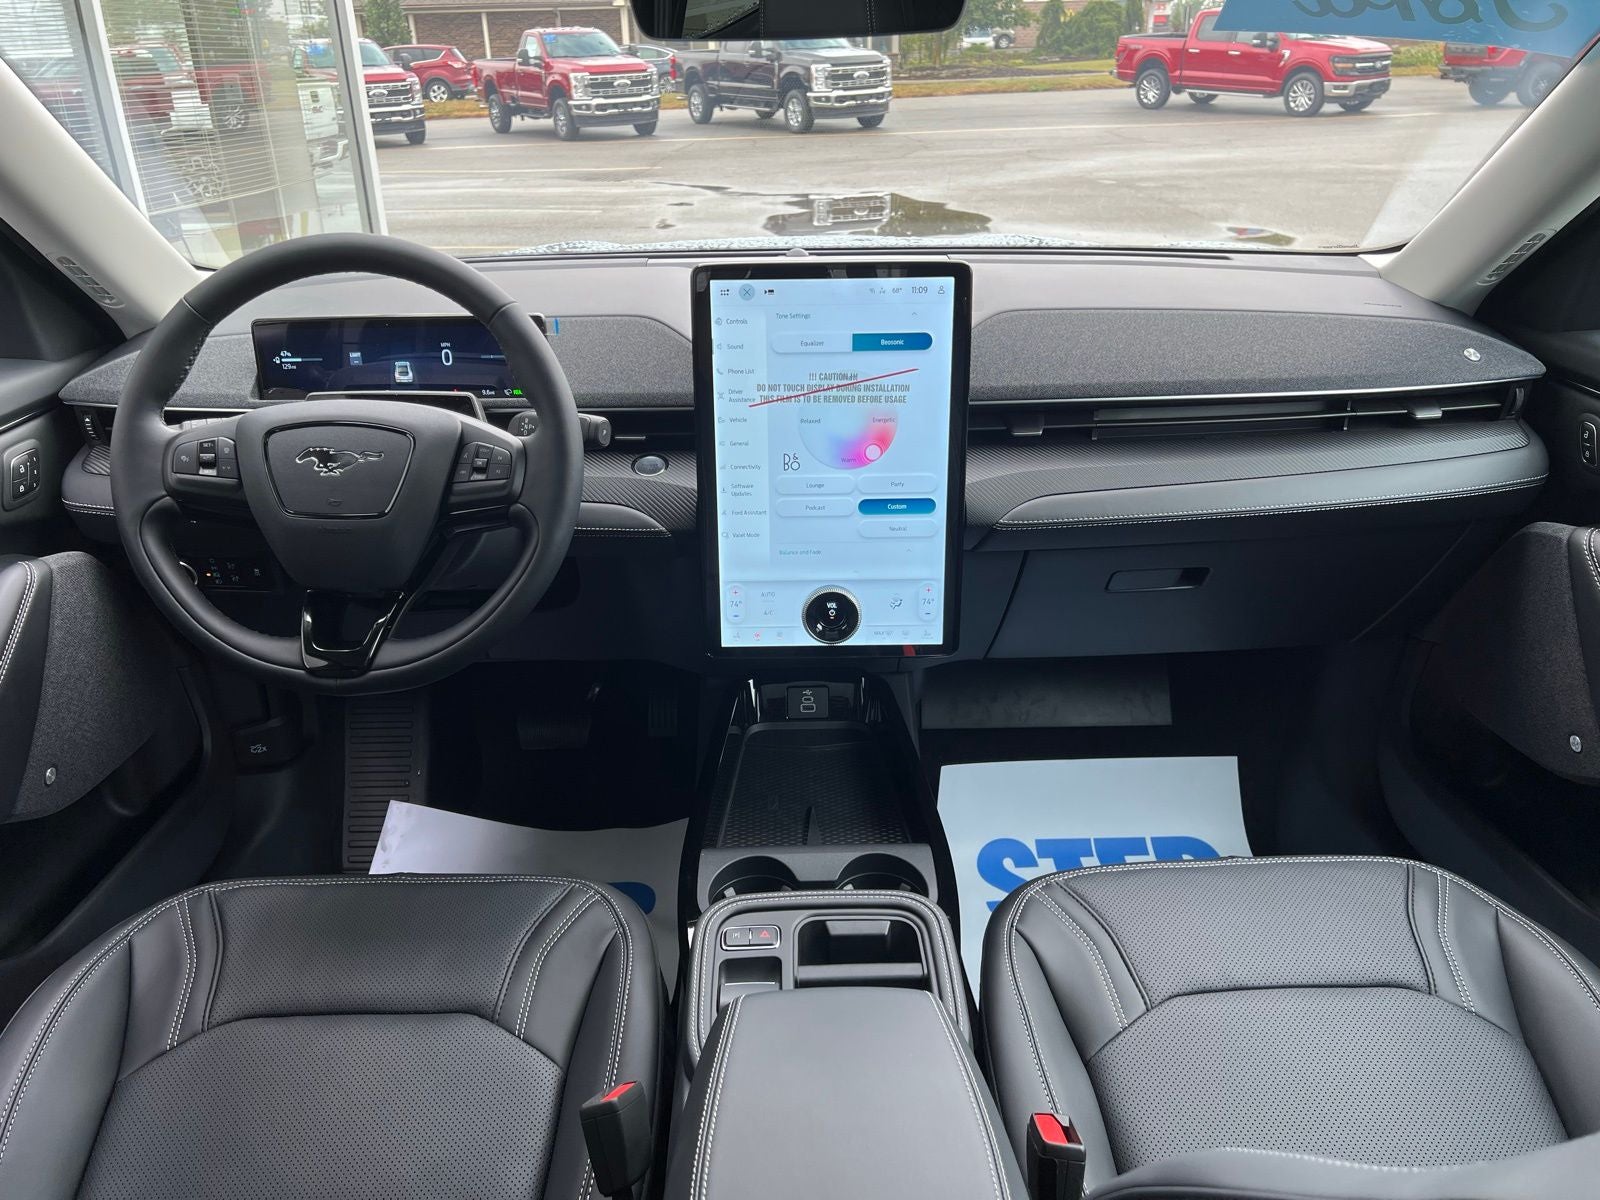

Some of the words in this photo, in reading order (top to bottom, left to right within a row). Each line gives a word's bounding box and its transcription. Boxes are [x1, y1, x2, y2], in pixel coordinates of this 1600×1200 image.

[911, 286, 928, 294] 11:09
[789, 312, 811, 320] Settings
[800, 340, 824, 348] Equalizer
[880, 338, 905, 346] Beosonic
[441, 348, 453, 366] 0
[818, 372, 849, 381] CAUTION
[756, 383, 766, 392] DO
[767, 383, 781, 392] NOT
[783, 383, 805, 392] TOUCH
[806, 383, 836, 392] DISPLAY
[837, 384, 862, 393] DURING
[863, 384, 911, 393] INSTALLATION
[760, 394, 775, 404] THIS
[794, 394, 800, 403] IS
[803, 395, 811, 403] TO
[812, 395, 821, 403] BE
[823, 395, 856, 404] REMOVED
[857, 395, 883, 404] BEFORE
[884, 395, 908, 404] USAGE
[872, 416, 896, 424] Energetic
[887, 502, 907, 510] Custom
[730, 600, 743, 608] 74°
[977, 836, 1221, 912] ST
